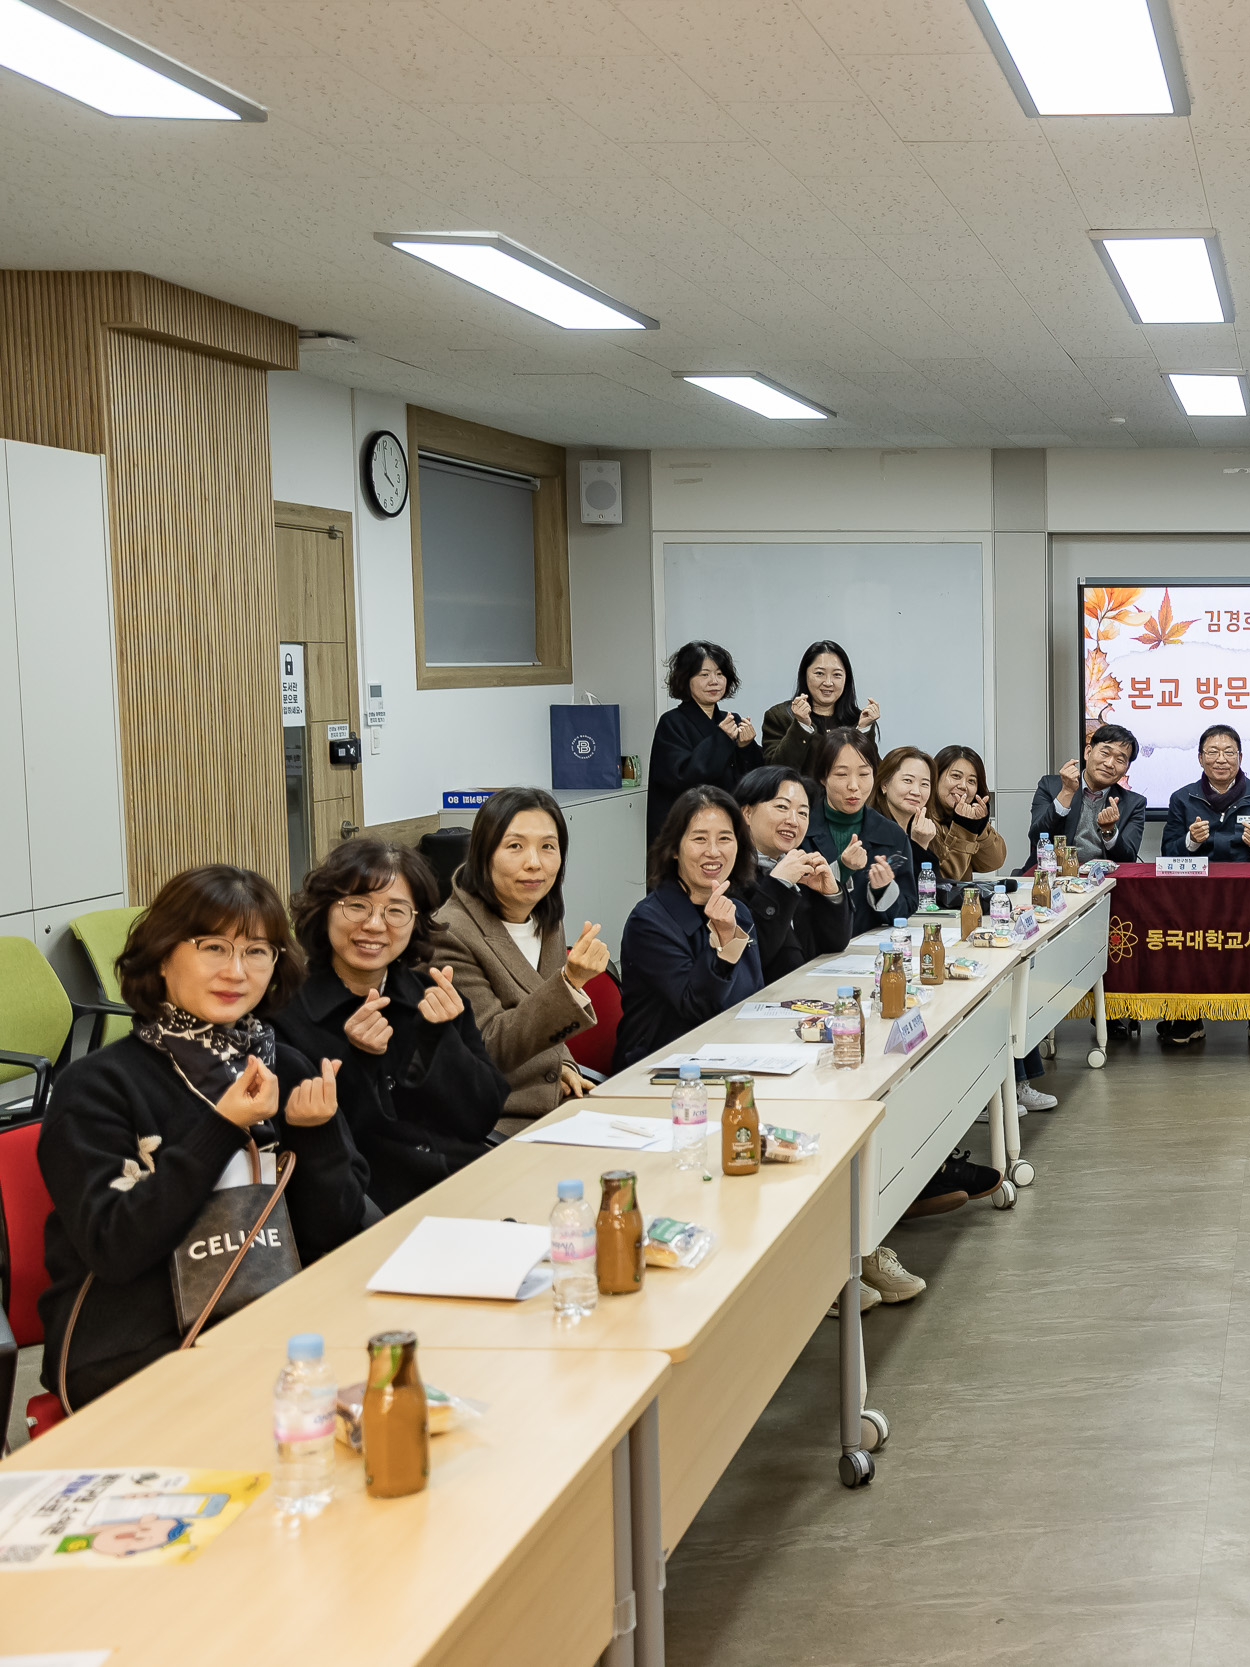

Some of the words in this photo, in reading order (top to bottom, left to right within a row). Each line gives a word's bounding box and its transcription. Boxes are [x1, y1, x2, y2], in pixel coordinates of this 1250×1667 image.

[376, 442, 381, 452] 11
[394, 458, 399, 468] 2
[396, 473, 400, 483] 3
[394, 487, 399, 497] 4
[383, 498, 387, 508] 6
[389, 496, 394, 506] 5
[282, 682, 298, 692] 도서관
[1128, 676, 1183, 710] 본교
[282, 694, 299, 704] 문으로
[187, 1228, 282, 1260] CELINE
